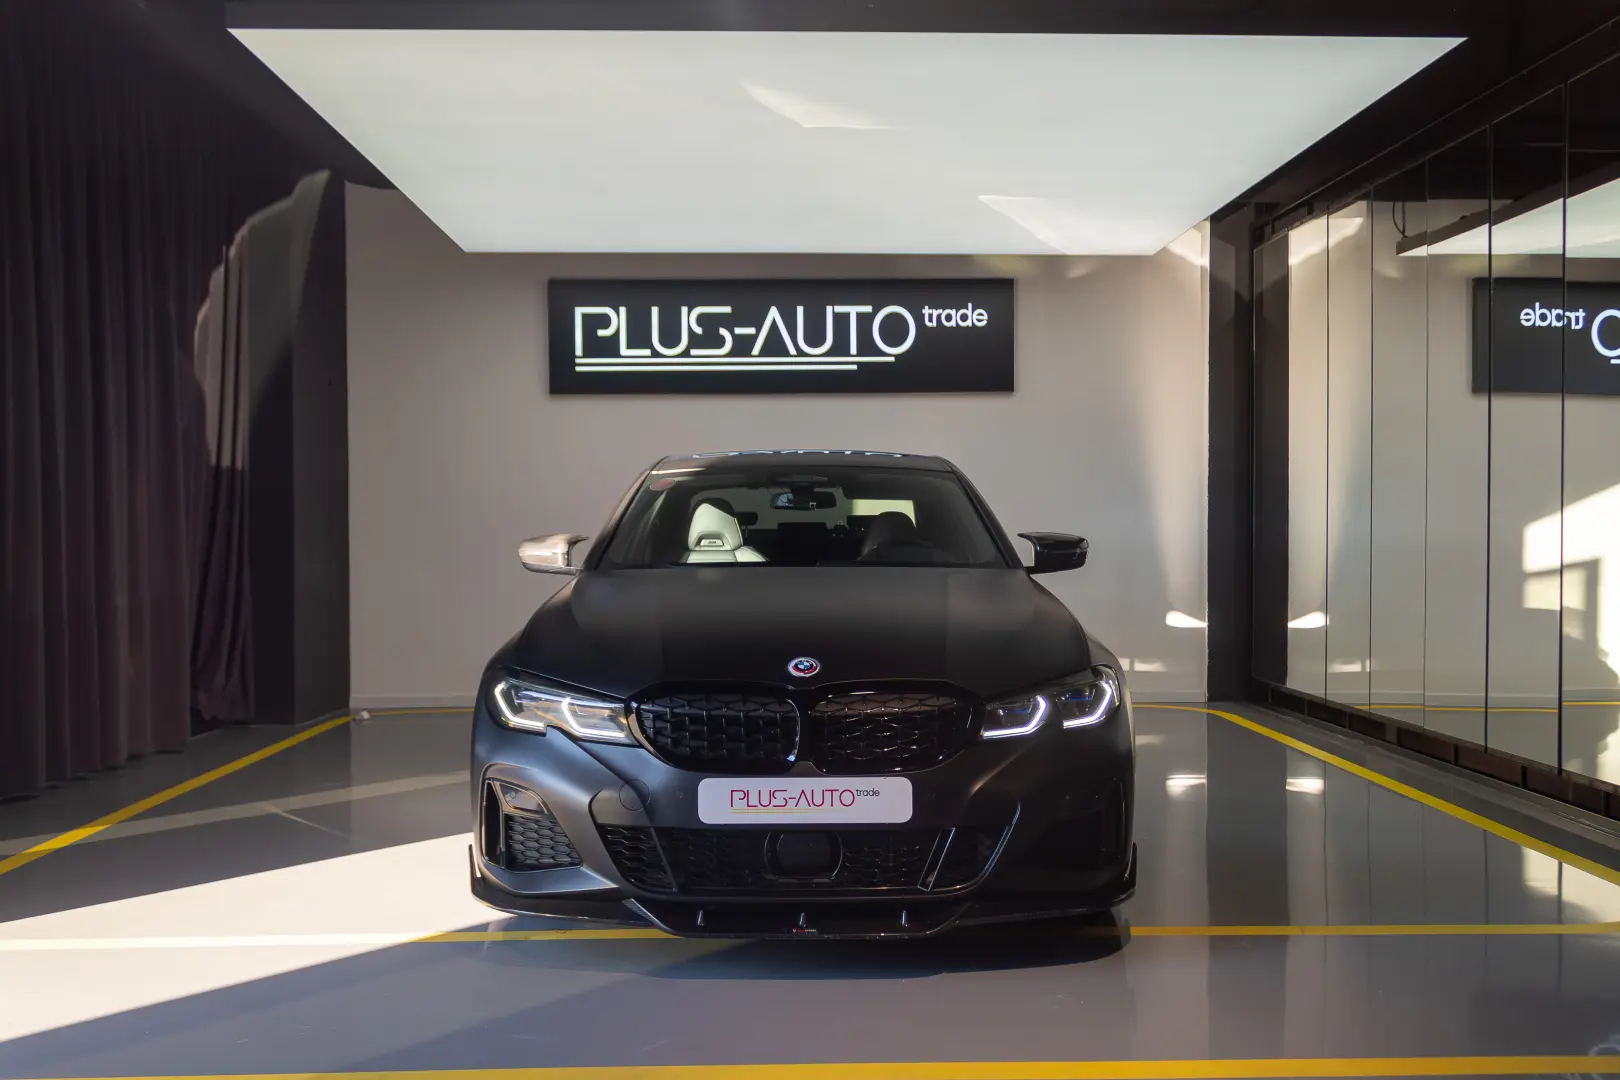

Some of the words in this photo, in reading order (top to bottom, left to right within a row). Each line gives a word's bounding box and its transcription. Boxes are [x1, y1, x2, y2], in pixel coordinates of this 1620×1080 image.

[574, 305, 916, 356] PLUS-AUTO
[922, 303, 988, 327] trade
[730, 789, 855, 808] PLUS-AUTO
[856, 788, 880, 797] trade
